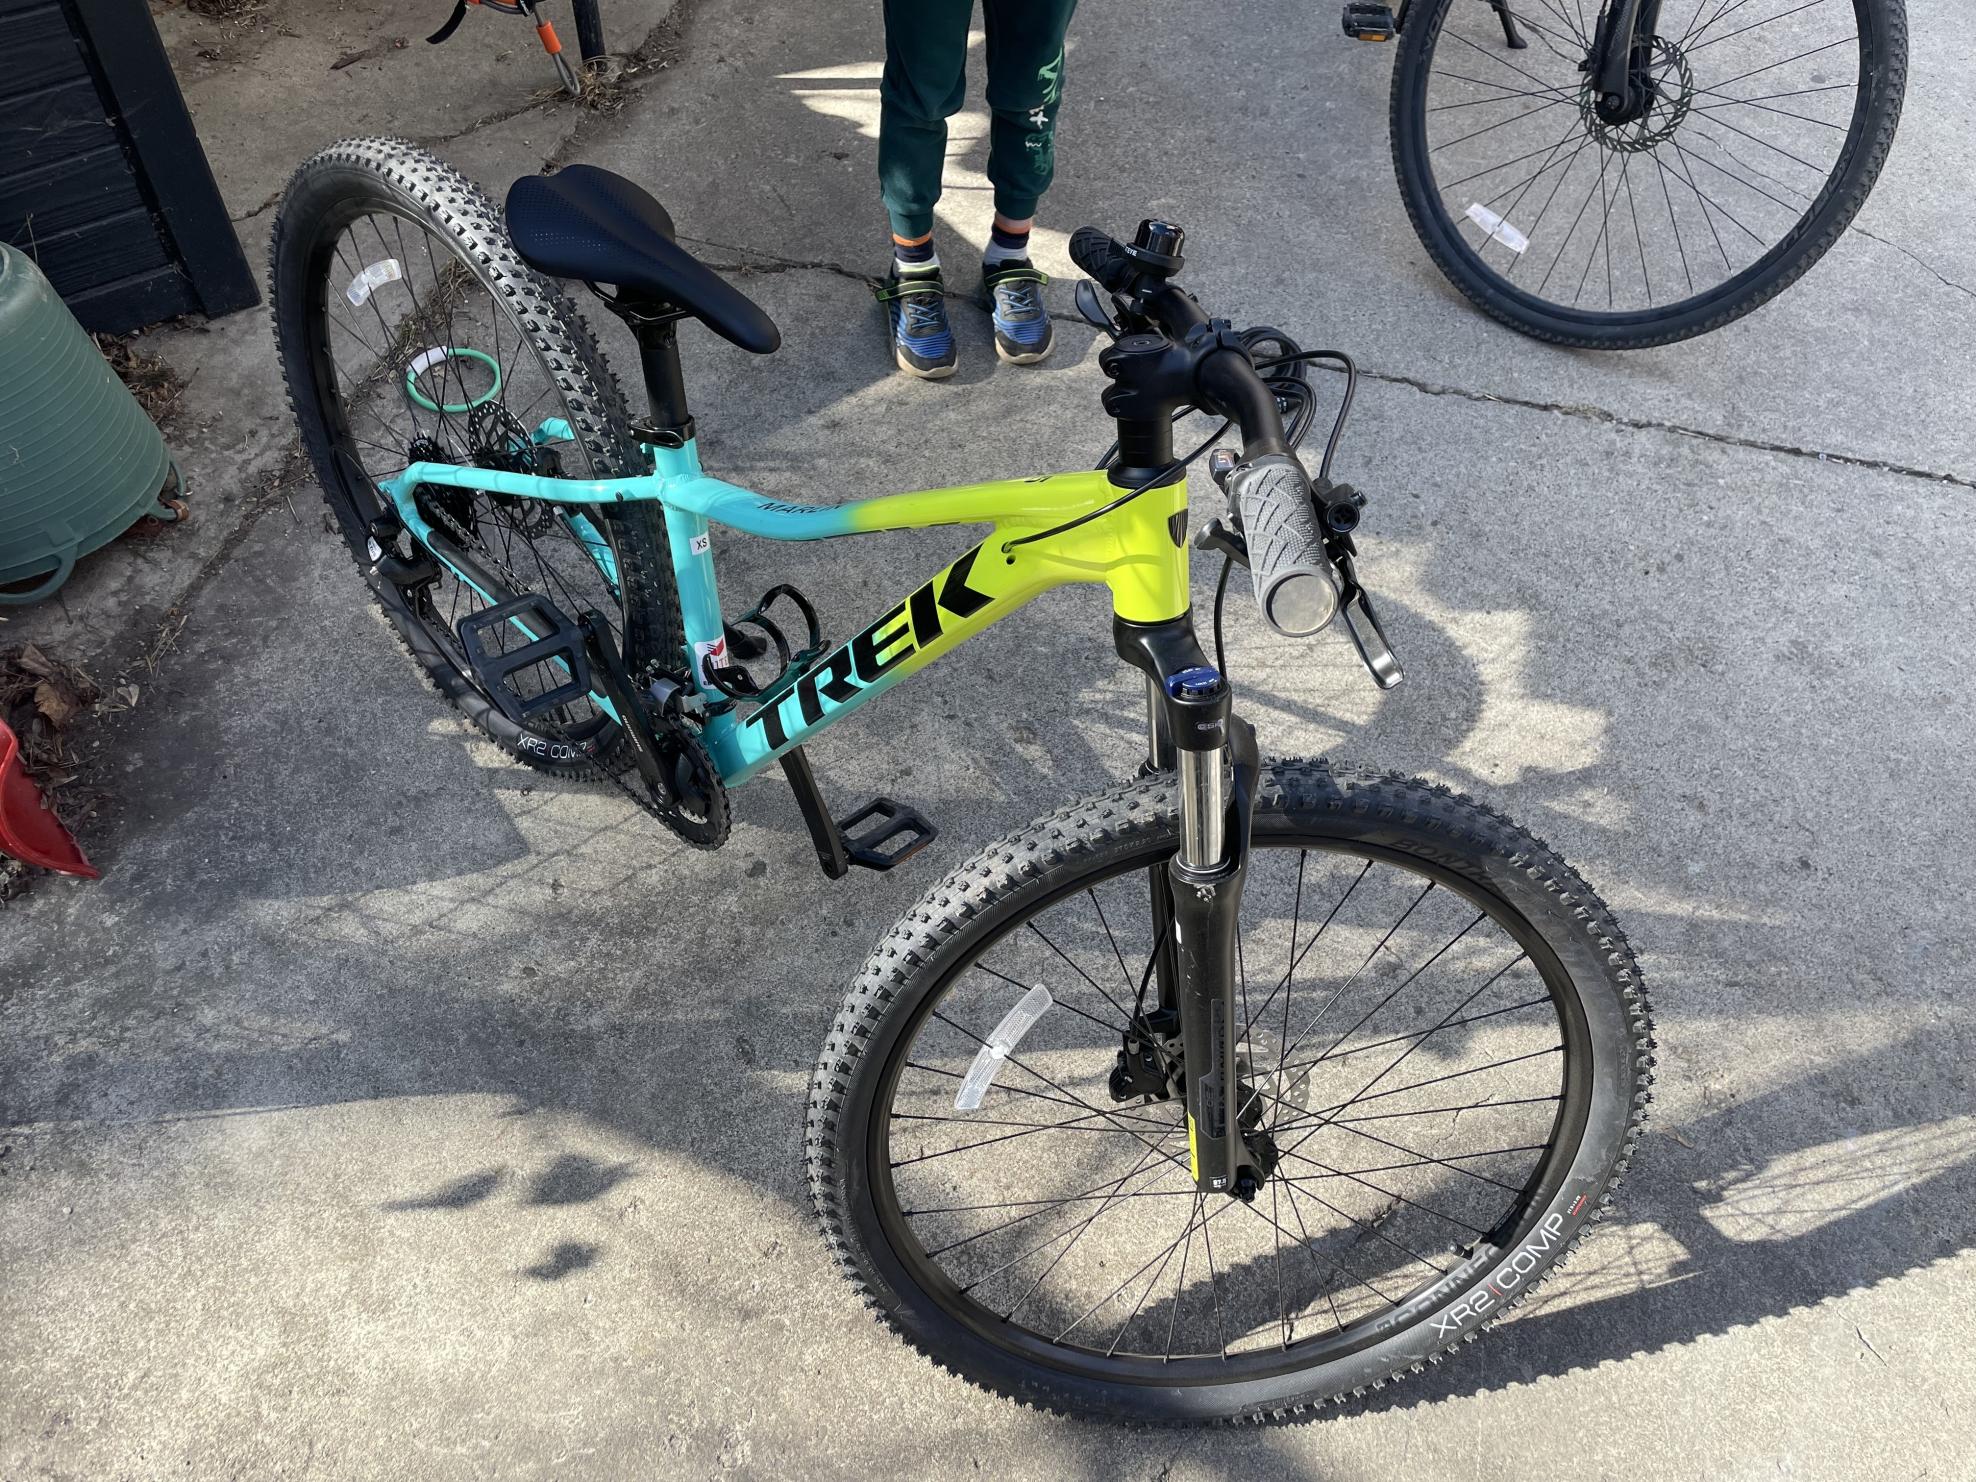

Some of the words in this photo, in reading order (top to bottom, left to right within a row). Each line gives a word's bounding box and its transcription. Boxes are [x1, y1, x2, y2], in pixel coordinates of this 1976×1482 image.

[696, 537, 708, 550] XS
[745, 541, 996, 751] TREK
[516, 733, 547, 757] XR2
[1430, 1290, 1495, 1339] XR2
[1496, 1213, 1564, 1289] COMP
